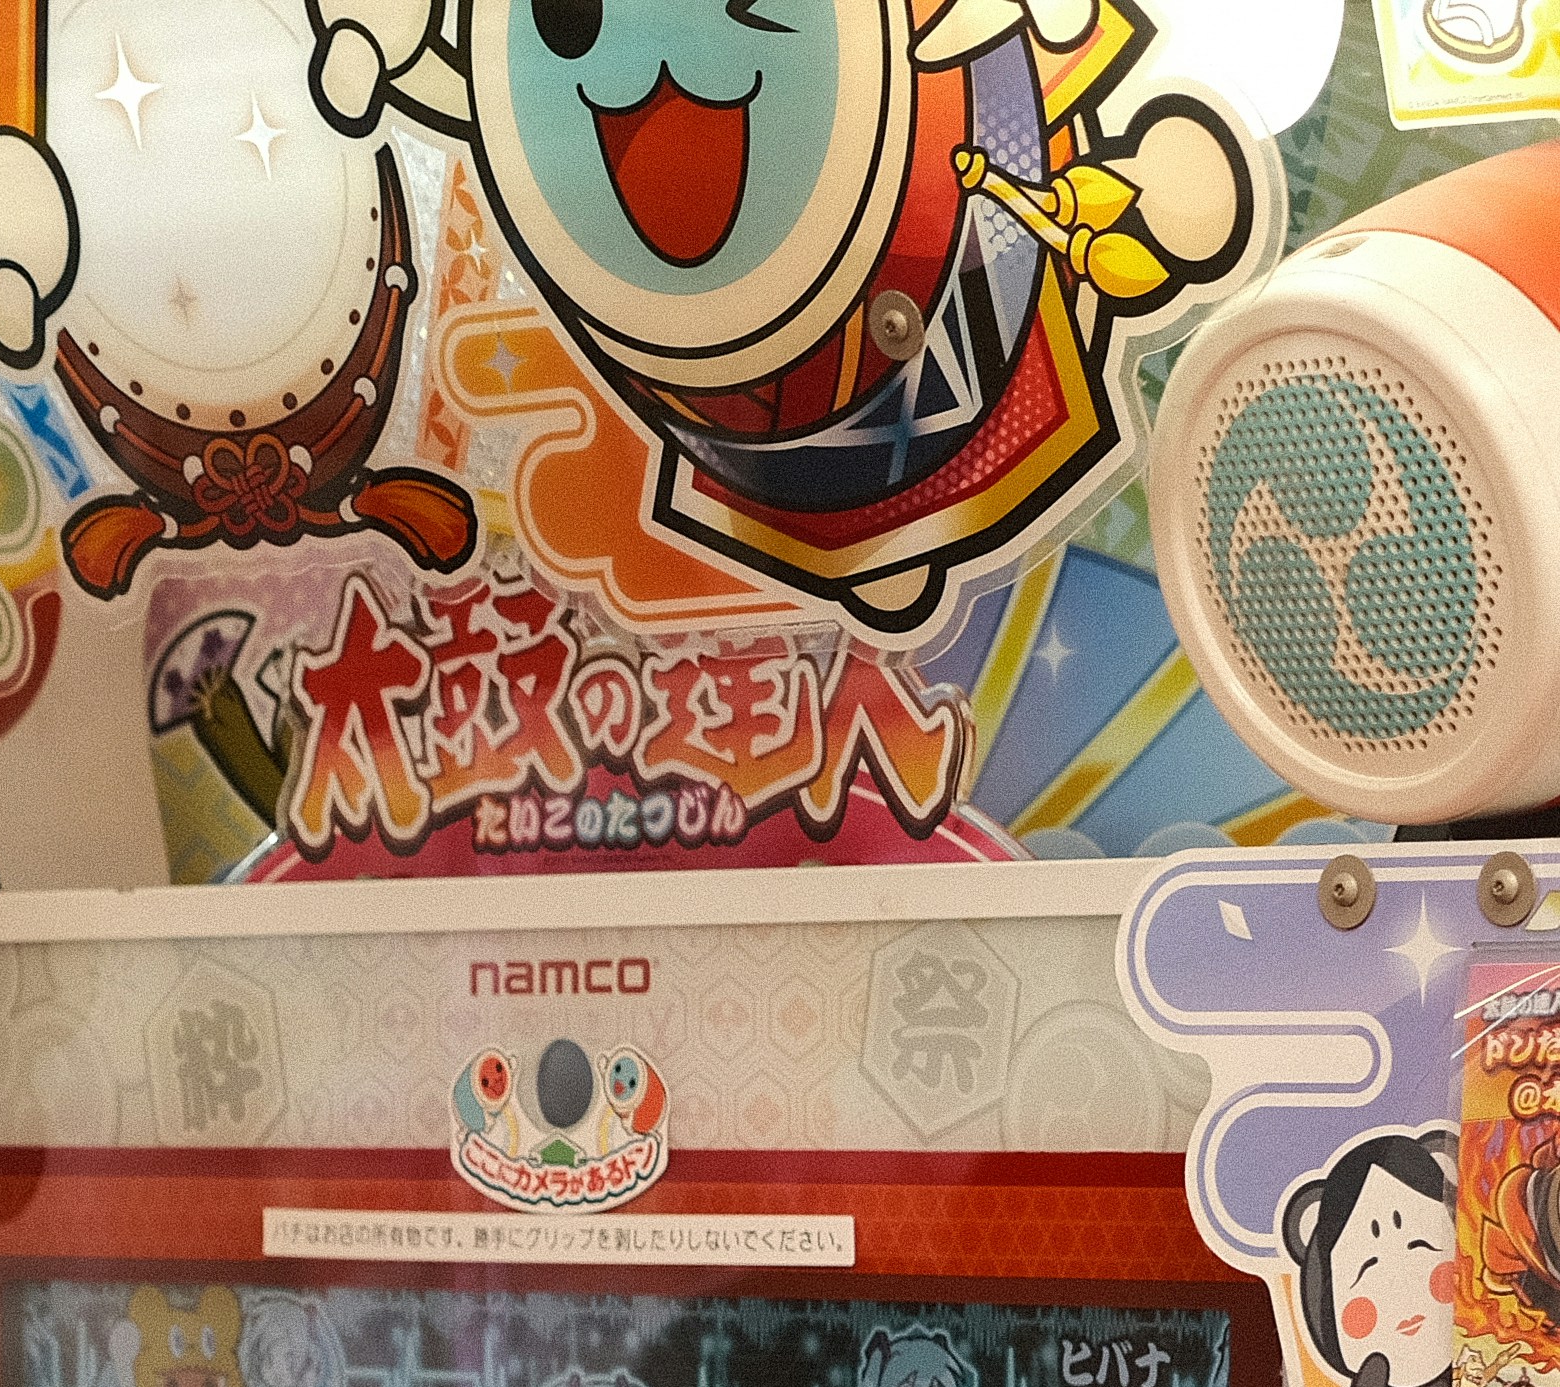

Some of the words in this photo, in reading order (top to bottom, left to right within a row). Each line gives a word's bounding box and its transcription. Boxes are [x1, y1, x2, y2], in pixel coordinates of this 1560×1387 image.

[295, 572, 962, 848] 太鼓の達人
[472, 786, 748, 853] たいこのたつじん
[469, 956, 652, 996] namco
